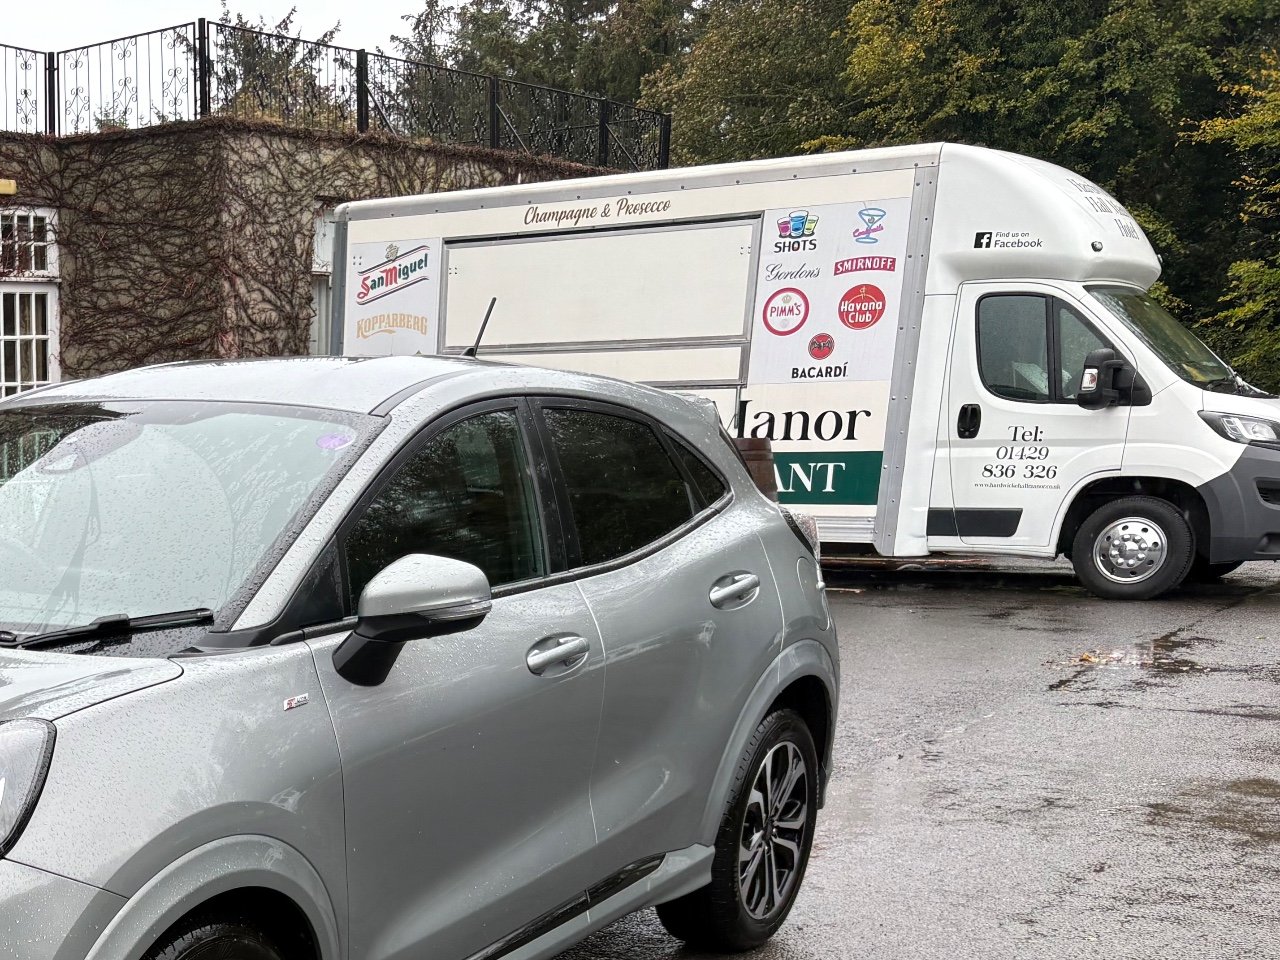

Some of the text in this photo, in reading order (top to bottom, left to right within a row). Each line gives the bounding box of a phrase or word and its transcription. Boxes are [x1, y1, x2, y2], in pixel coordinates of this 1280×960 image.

[524, 198, 671, 227] Champagne & Prosecco
[773, 239, 817, 254] SHOTS
[994, 238, 1043, 248] Facebook
[765, 262, 821, 282] Gordon's
[769, 302, 802, 318] PIMM'S
[840, 300, 883, 313] Havana
[356, 312, 429, 339] KOPPARBERG
[848, 311, 873, 324] Club
[791, 361, 849, 379] BACARDÍ
[1007, 425, 1044, 442] Tel:
[995, 445, 1050, 461] 01429
[981, 463, 1058, 480] 836 326
